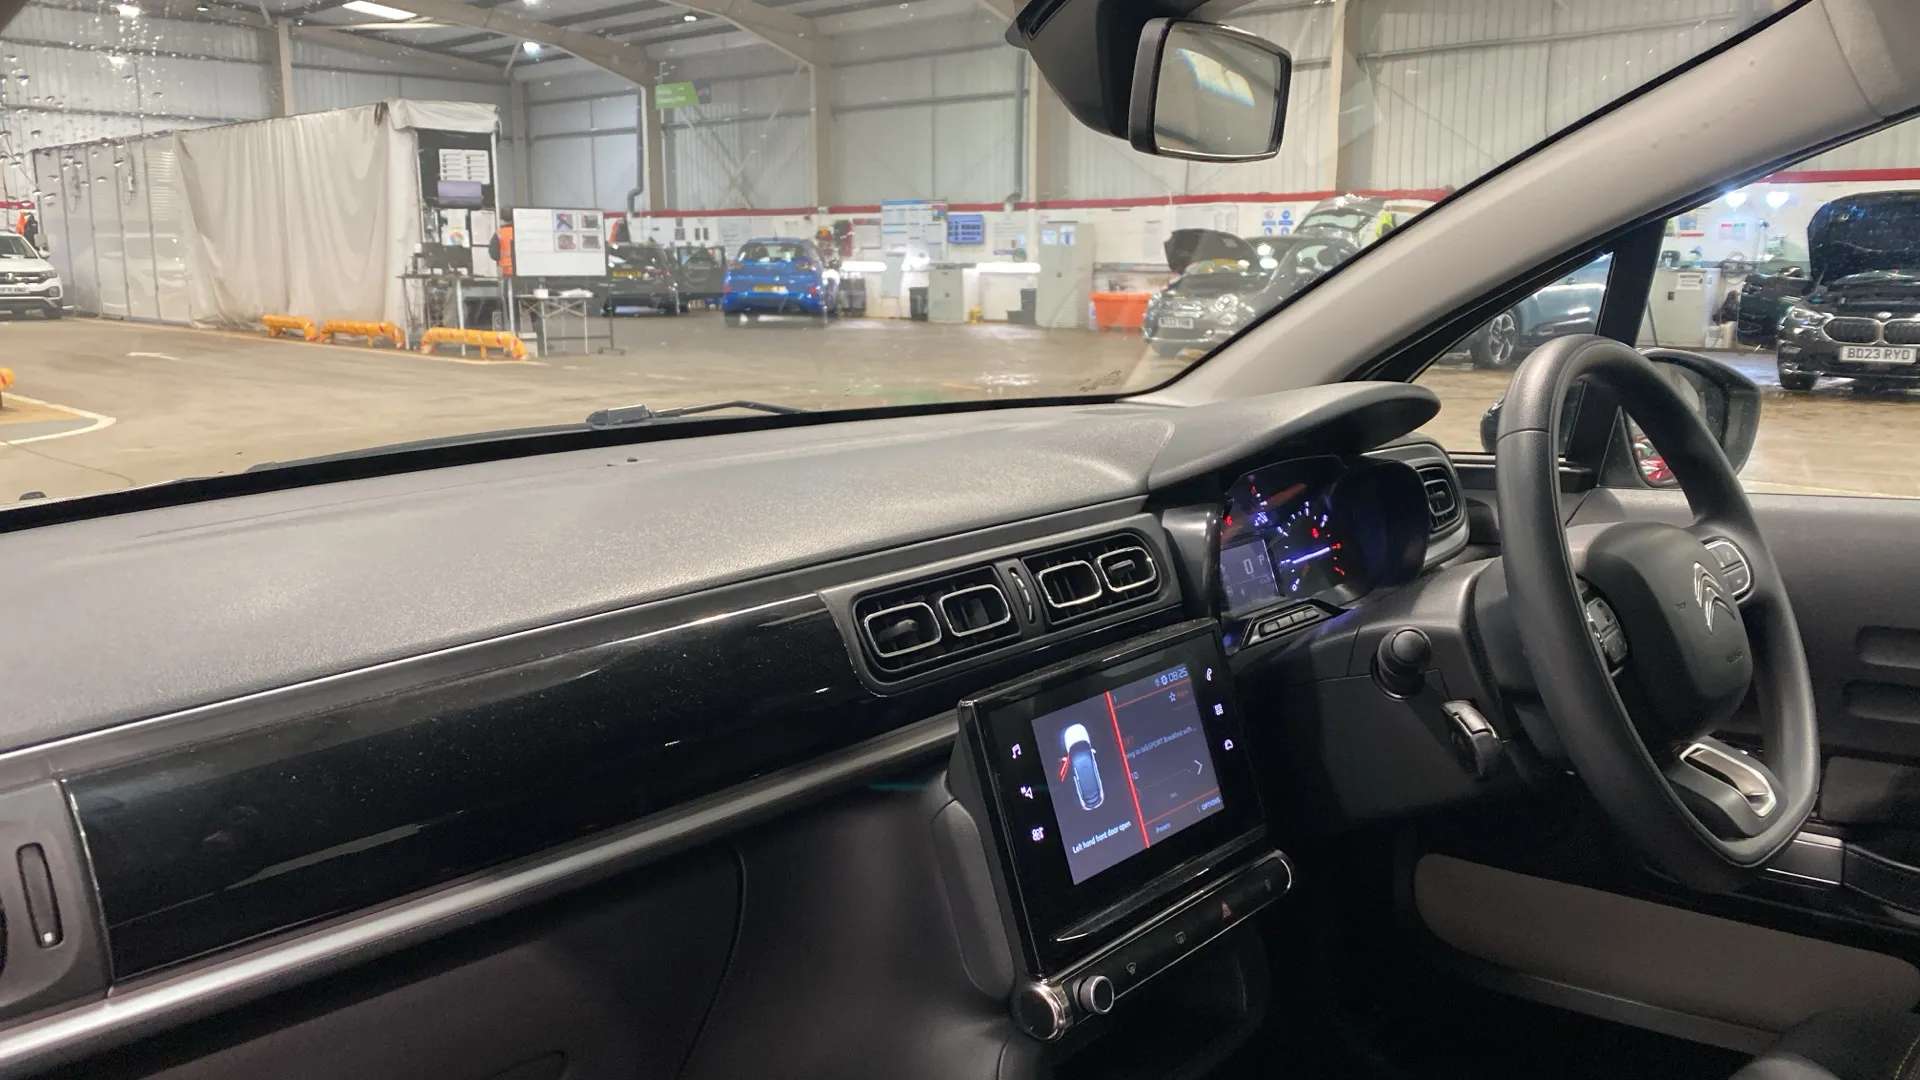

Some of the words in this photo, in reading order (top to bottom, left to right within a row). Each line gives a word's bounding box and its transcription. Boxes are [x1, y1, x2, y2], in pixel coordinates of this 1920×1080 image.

[1848, 348, 1881, 359] BD23
[1072, 842, 1082, 854] Left
[1082, 835, 1096, 849] hand
[1095, 830, 1107, 842] front
[1107, 825, 1119, 837] door
[1118, 820, 1132, 832] open
